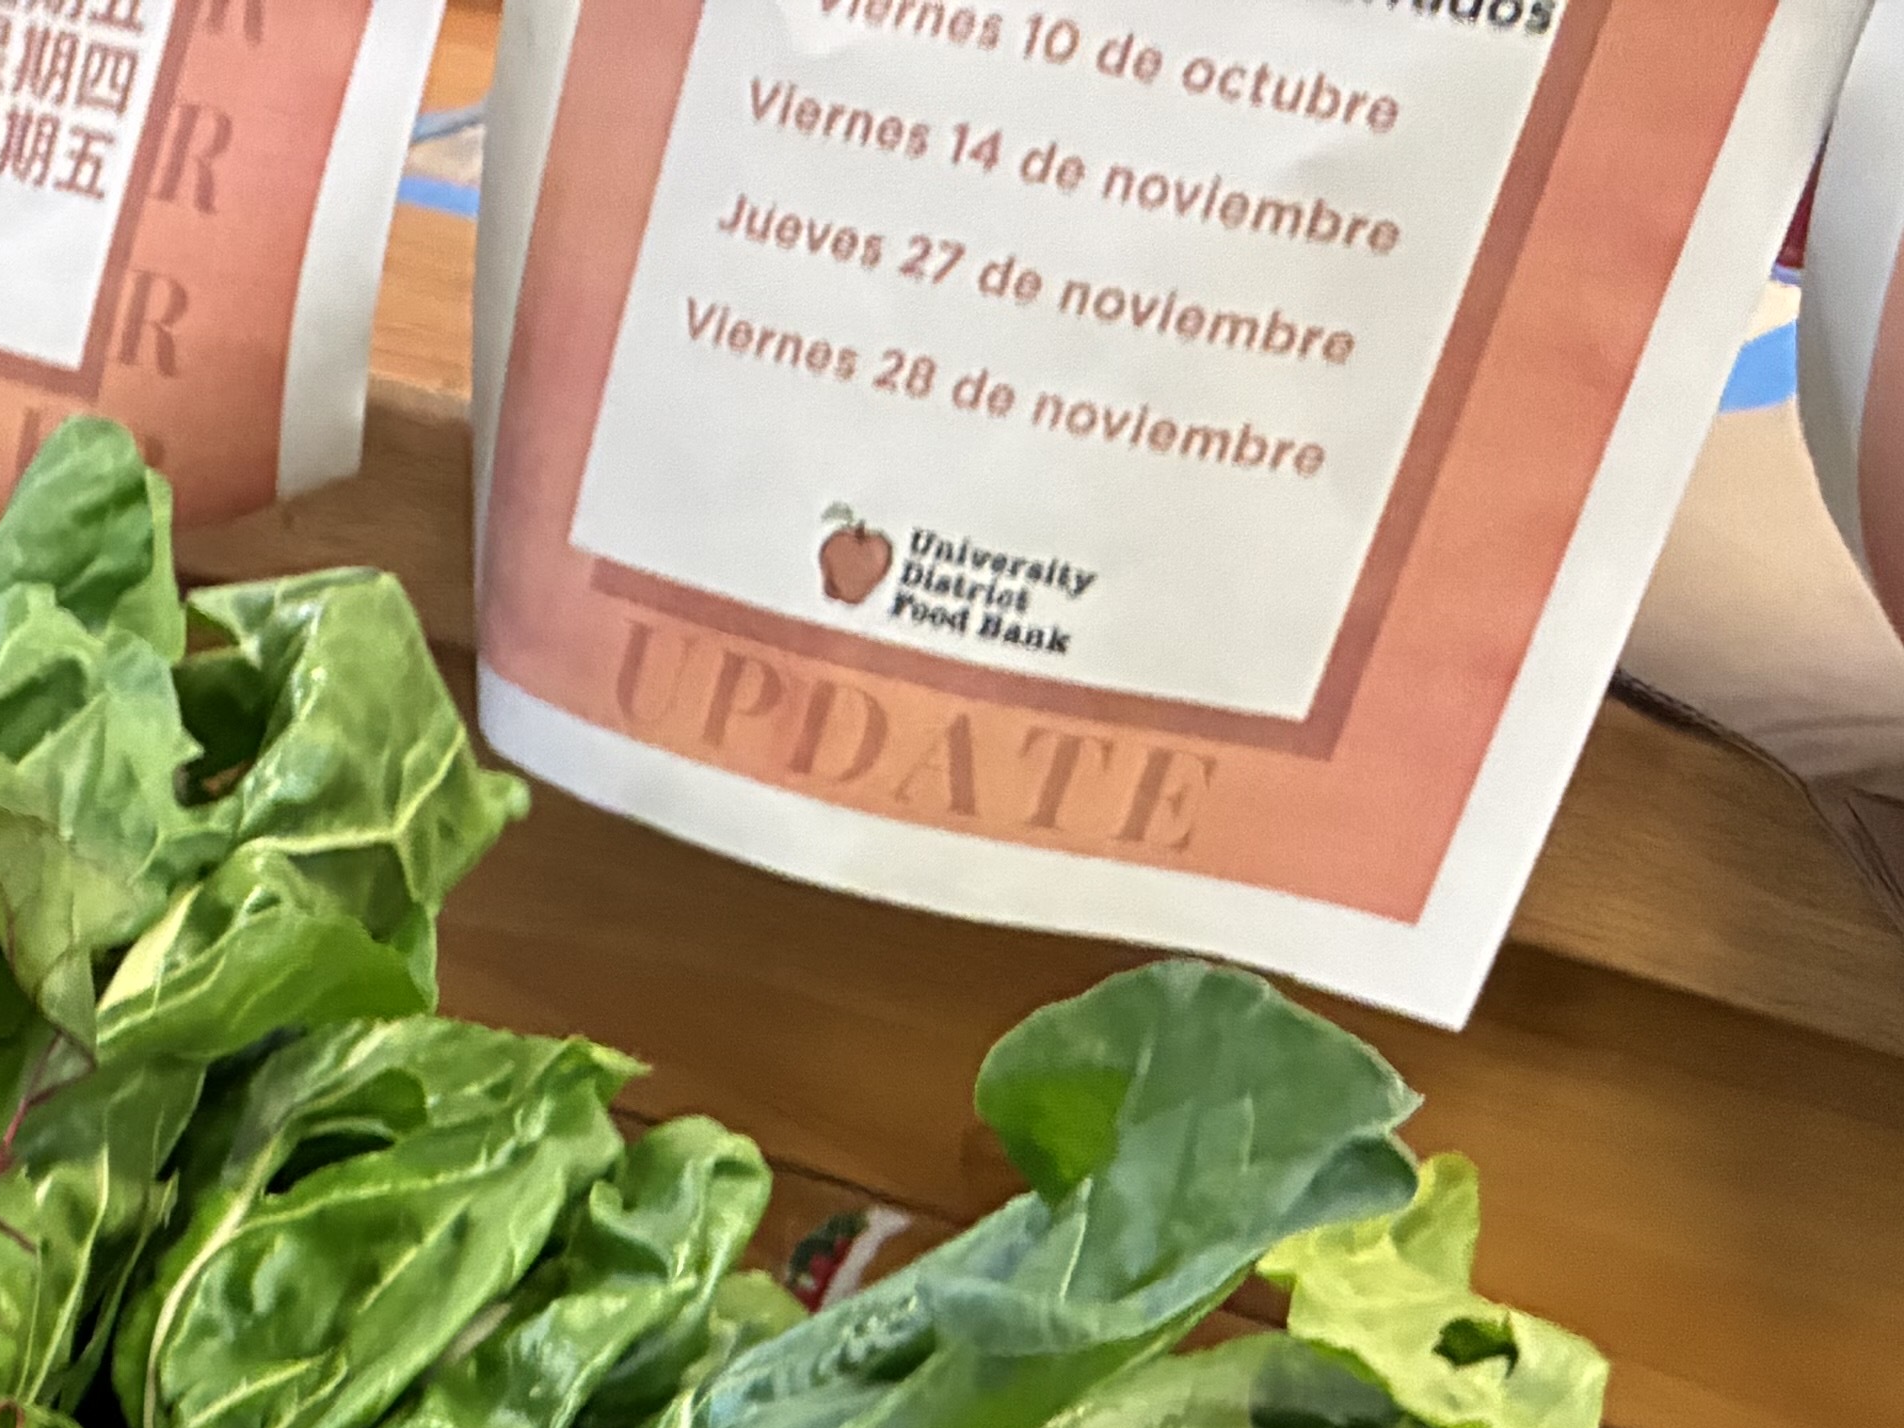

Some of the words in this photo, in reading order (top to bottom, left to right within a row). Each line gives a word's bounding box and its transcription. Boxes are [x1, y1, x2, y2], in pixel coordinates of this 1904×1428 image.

[1021, 12, 1081, 65] 10
[1096, 33, 1163, 87] de
[1181, 52, 1400, 134] octubre
[746, 76, 929, 159] Viernes
[948, 120, 1002, 173] 14
[1019, 140, 1086, 192] de
[1102, 162, 1401, 256] noviembre
[717, 193, 886, 270] Jueves
[898, 233, 967, 285] 27
[978, 255, 1043, 305] de
[1058, 276, 1356, 366] noviembre
[685, 295, 859, 381] Viernes
[872, 348, 938, 400] 28
[950, 368, 1016, 417] de
[1032, 390, 1327, 479] noviembre
[889, 593, 971, 637] Food
[976, 613, 1072, 656] Bank
[900, 560, 1032, 614] District
[909, 527, 1096, 599] University
[614, 618, 1219, 856] UPDATE
